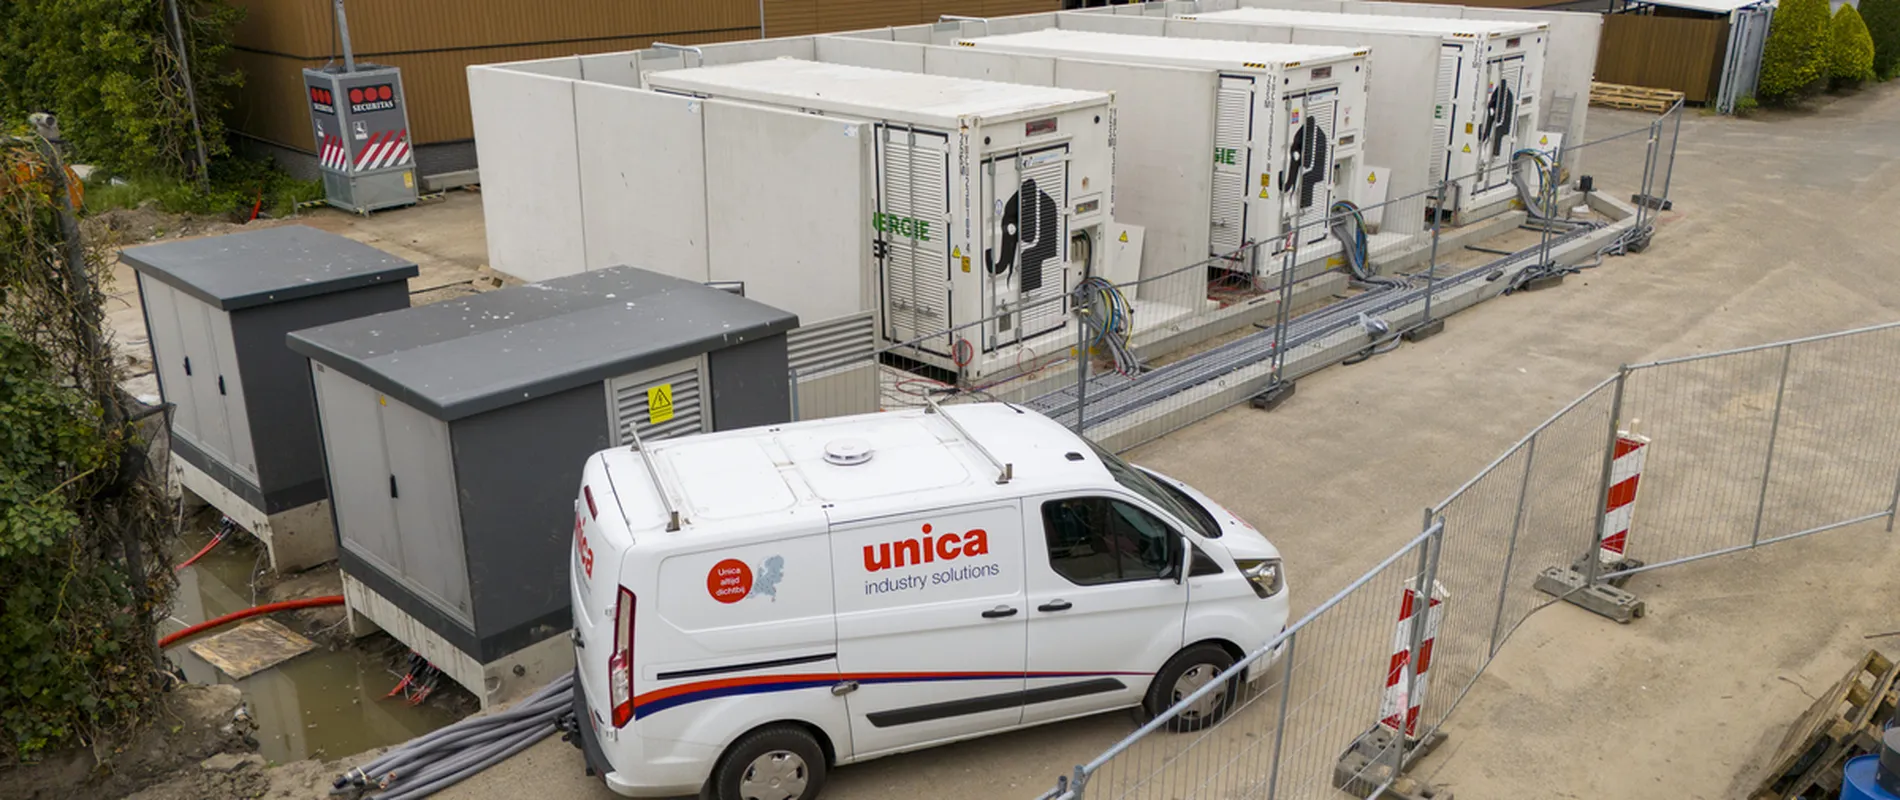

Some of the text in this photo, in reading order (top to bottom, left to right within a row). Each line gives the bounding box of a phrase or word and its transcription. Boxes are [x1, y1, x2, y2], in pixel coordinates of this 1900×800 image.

[352, 100, 394, 113] SECURITAS
[863, 523, 989, 572] unica
[717, 567, 742, 576] Unica
[864, 563, 1000, 595] industry solutions
[715, 586, 745, 596] dichtbij
